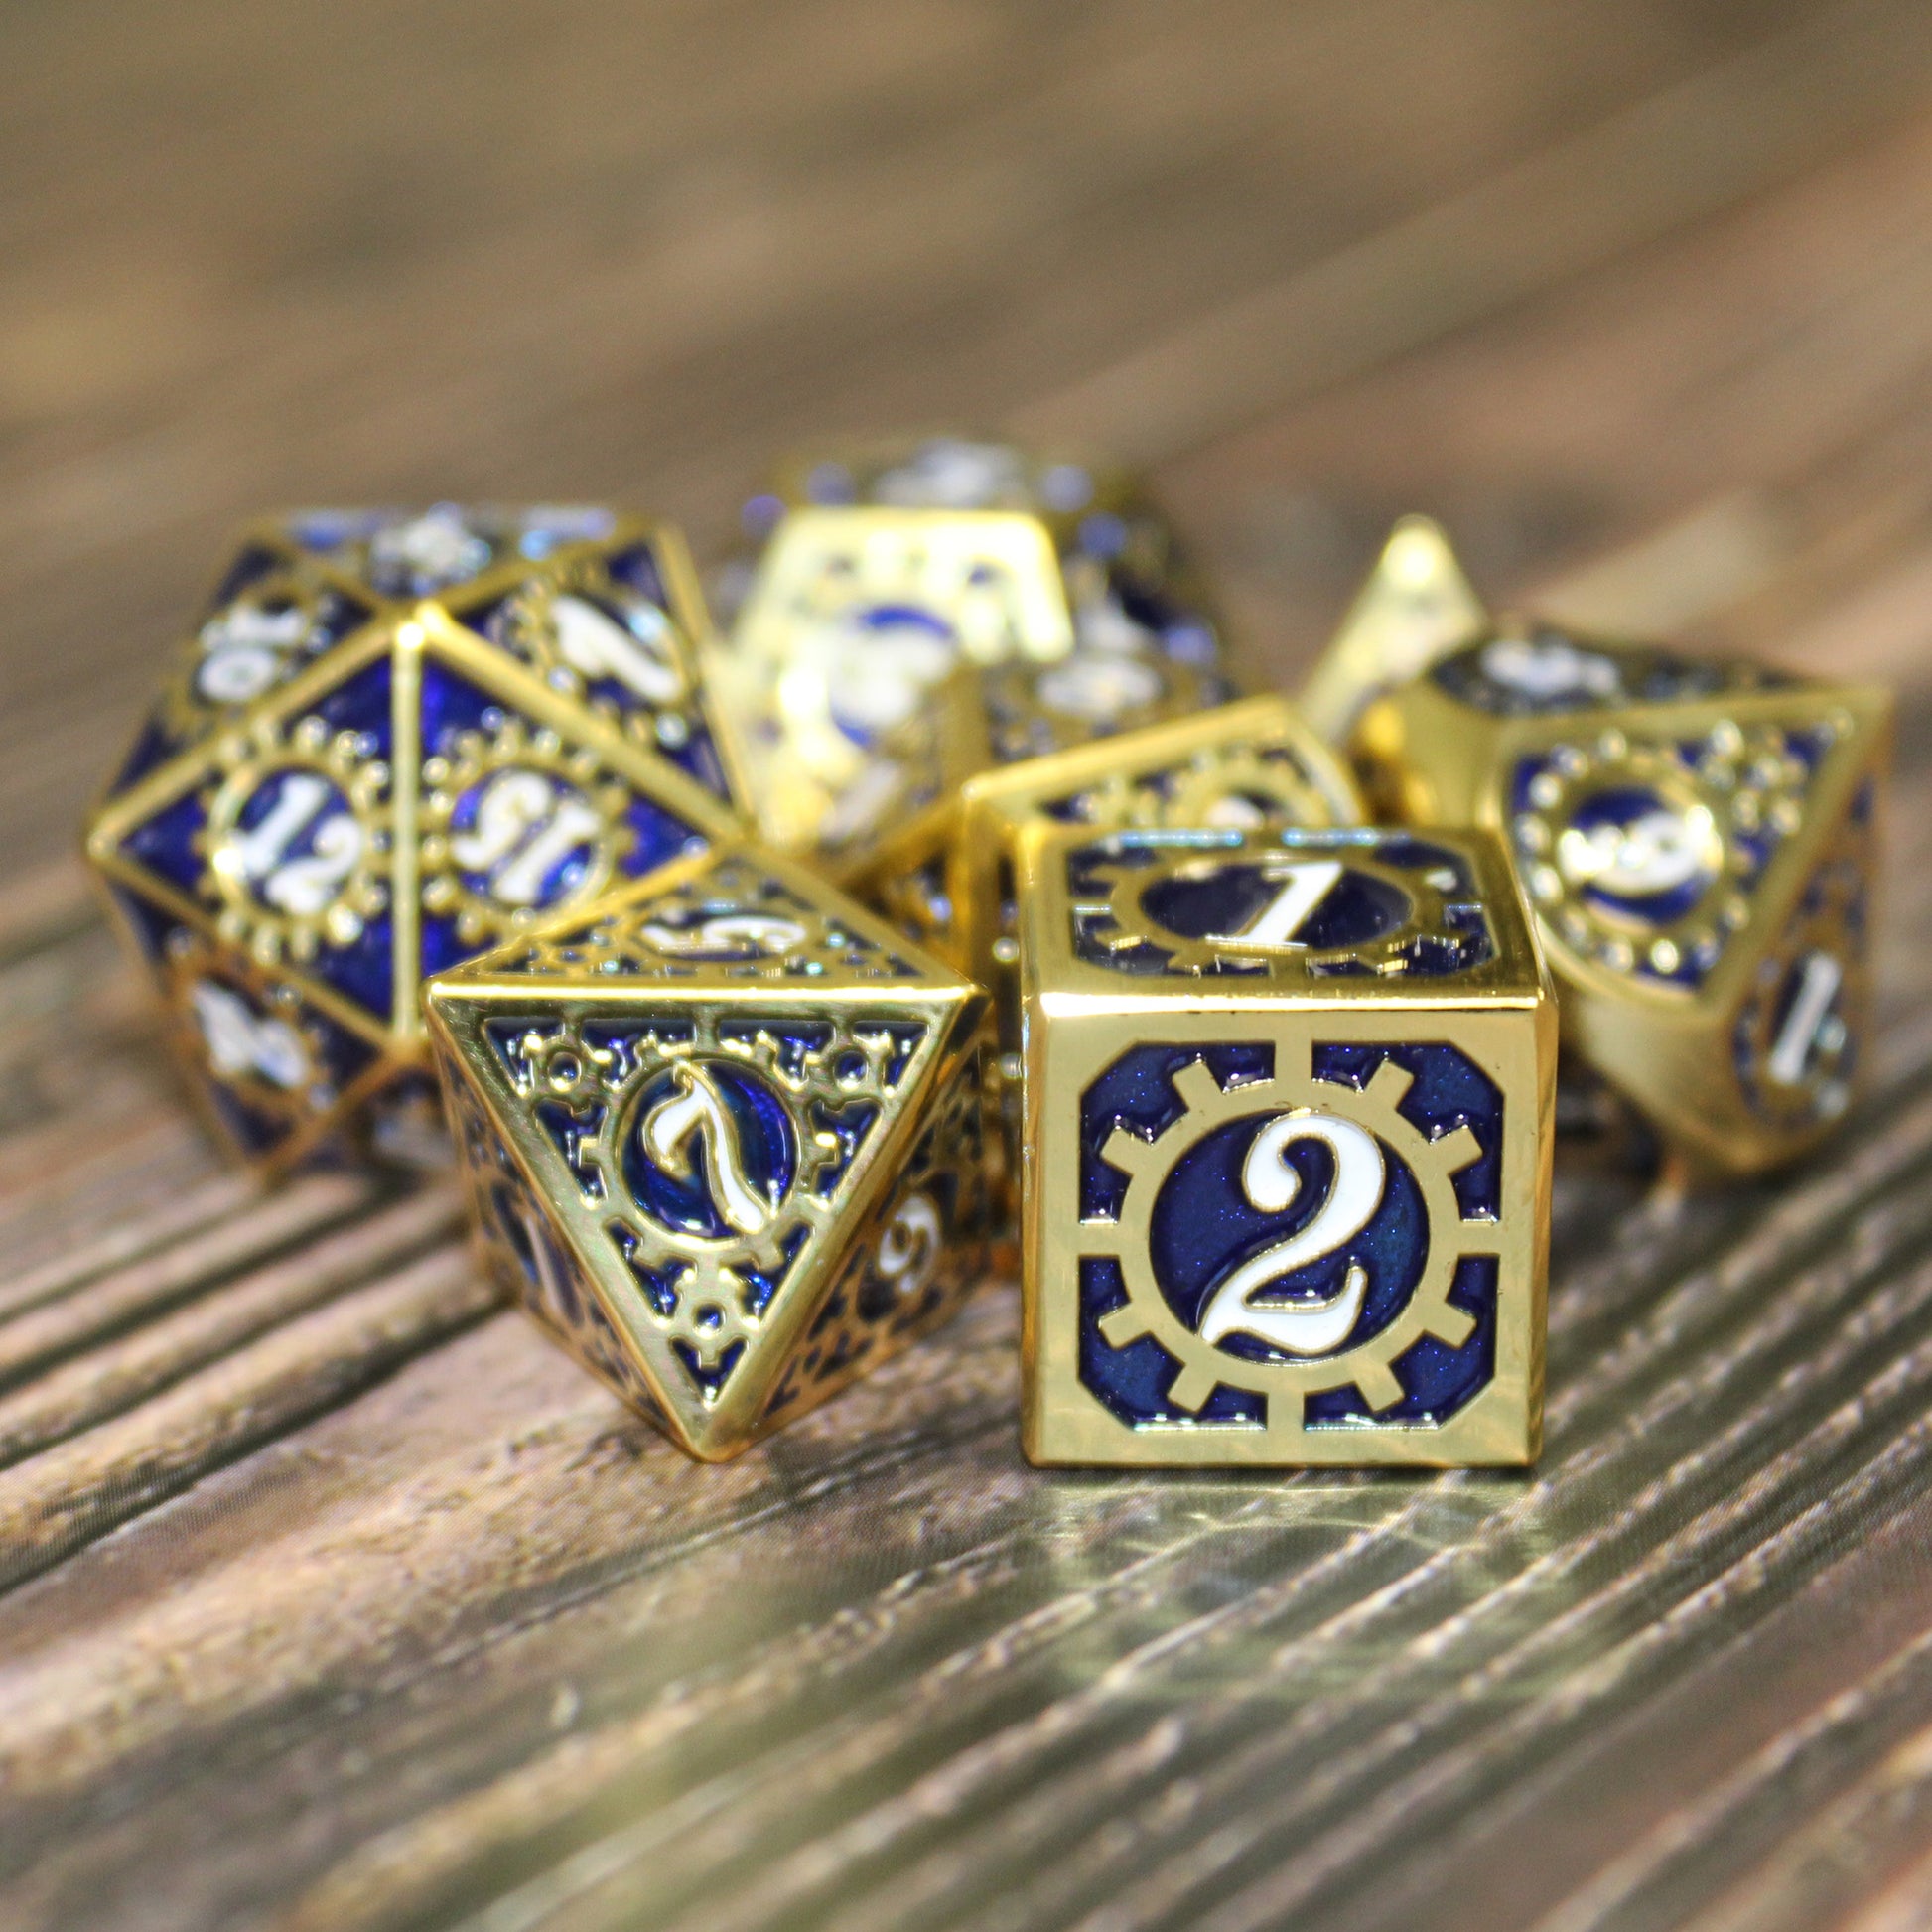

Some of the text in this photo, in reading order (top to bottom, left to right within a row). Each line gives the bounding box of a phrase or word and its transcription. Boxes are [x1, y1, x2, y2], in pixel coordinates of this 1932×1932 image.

[236, 772, 363, 914] 12
[1205, 860, 1342, 950] 1
[1198, 1108, 1386, 1354] 2
